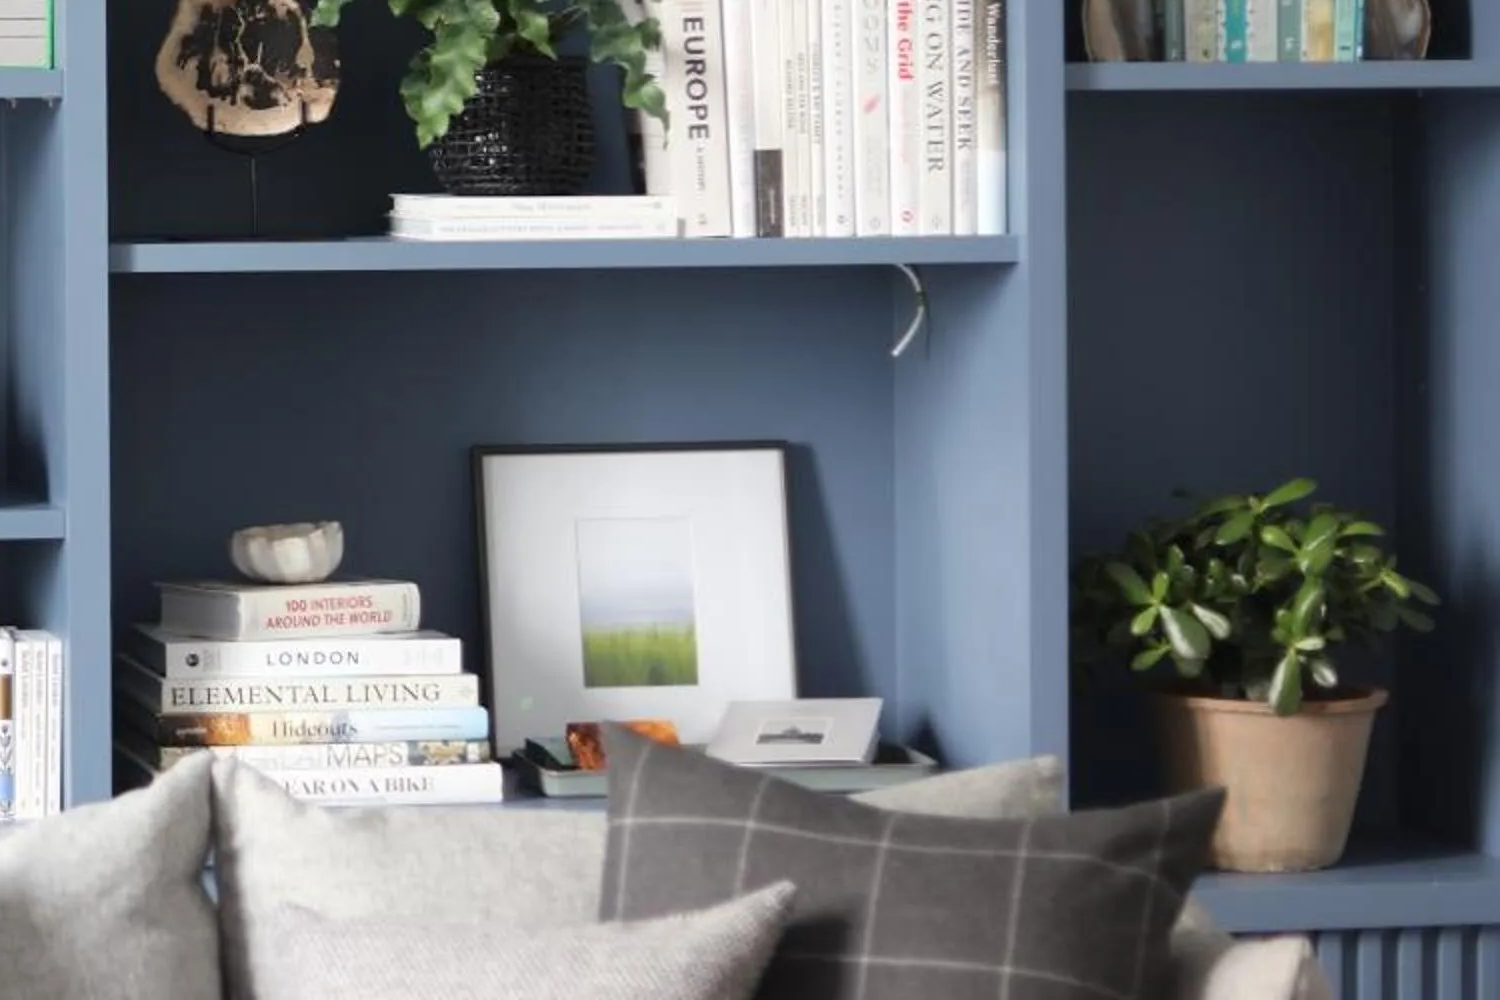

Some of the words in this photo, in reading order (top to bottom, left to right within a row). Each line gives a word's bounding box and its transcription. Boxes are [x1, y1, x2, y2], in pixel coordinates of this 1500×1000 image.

[897, 1, 914, 31] the
[897, 37, 914, 81] Grid
[925, 32, 945, 70] ON
[986, 2, 1001, 86] Wanderlust
[683, 16, 709, 140] EUROPE
[957, 47, 971, 87] AND
[926, 81, 946, 172] WATER
[957, 96, 972, 151] SEEK
[286, 599, 307, 612] 100
[310, 595, 373, 610] INTERIORS
[265, 614, 321, 629] AROUND
[324, 613, 346, 626] THE
[348, 611, 392, 625] WORLD
[266, 652, 360, 666] LONDON
[170, 685, 339, 706] ELEMENTAL
[345, 683, 441, 703] LIVING
[271, 719, 359, 738] Hideouts
[326, 745, 401, 768] MAPS
[331, 777, 360, 795] ON
[369, 777, 380, 794] A
[385, 776, 433, 793] BIKE
